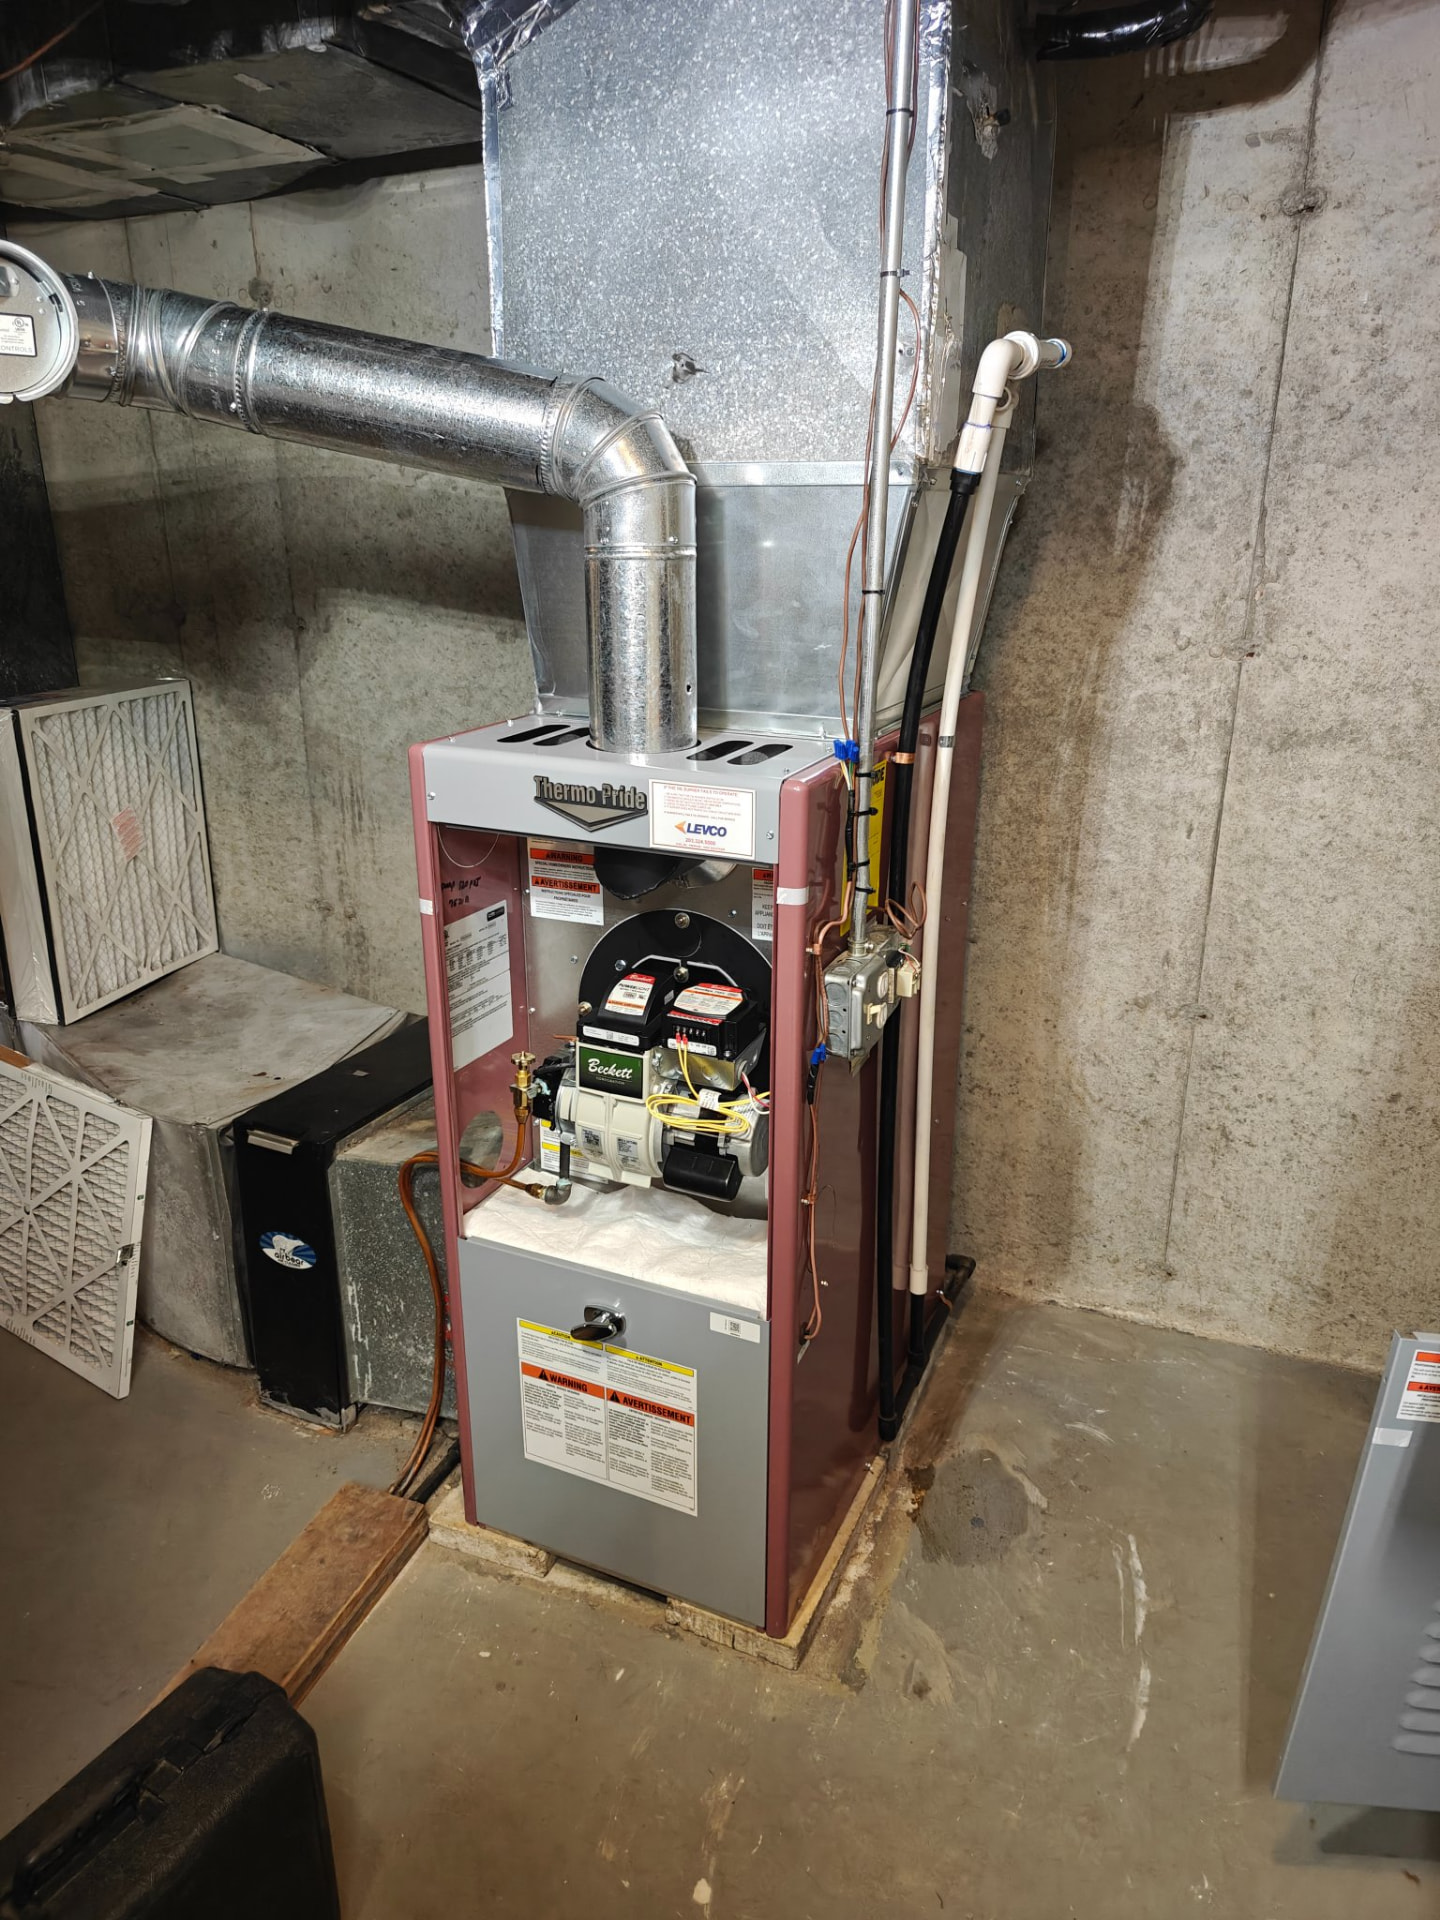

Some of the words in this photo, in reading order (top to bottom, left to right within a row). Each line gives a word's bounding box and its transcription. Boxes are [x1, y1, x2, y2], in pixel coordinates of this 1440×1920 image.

[534, 775, 597, 804] Thermo
[601, 783, 648, 810] Pride
[686, 822, 727, 838] LEVCO
[550, 853, 583, 863] WARNING
[540, 878, 598, 892] AVERTISSEMENT
[588, 1057, 633, 1079] Beckett
[553, 1331, 571, 1340] CAUTION
[640, 1356, 663, 1367] ATTENTION
[550, 1373, 588, 1392] WARNING
[622, 1396, 691, 1424] AVERTISSEMENT
